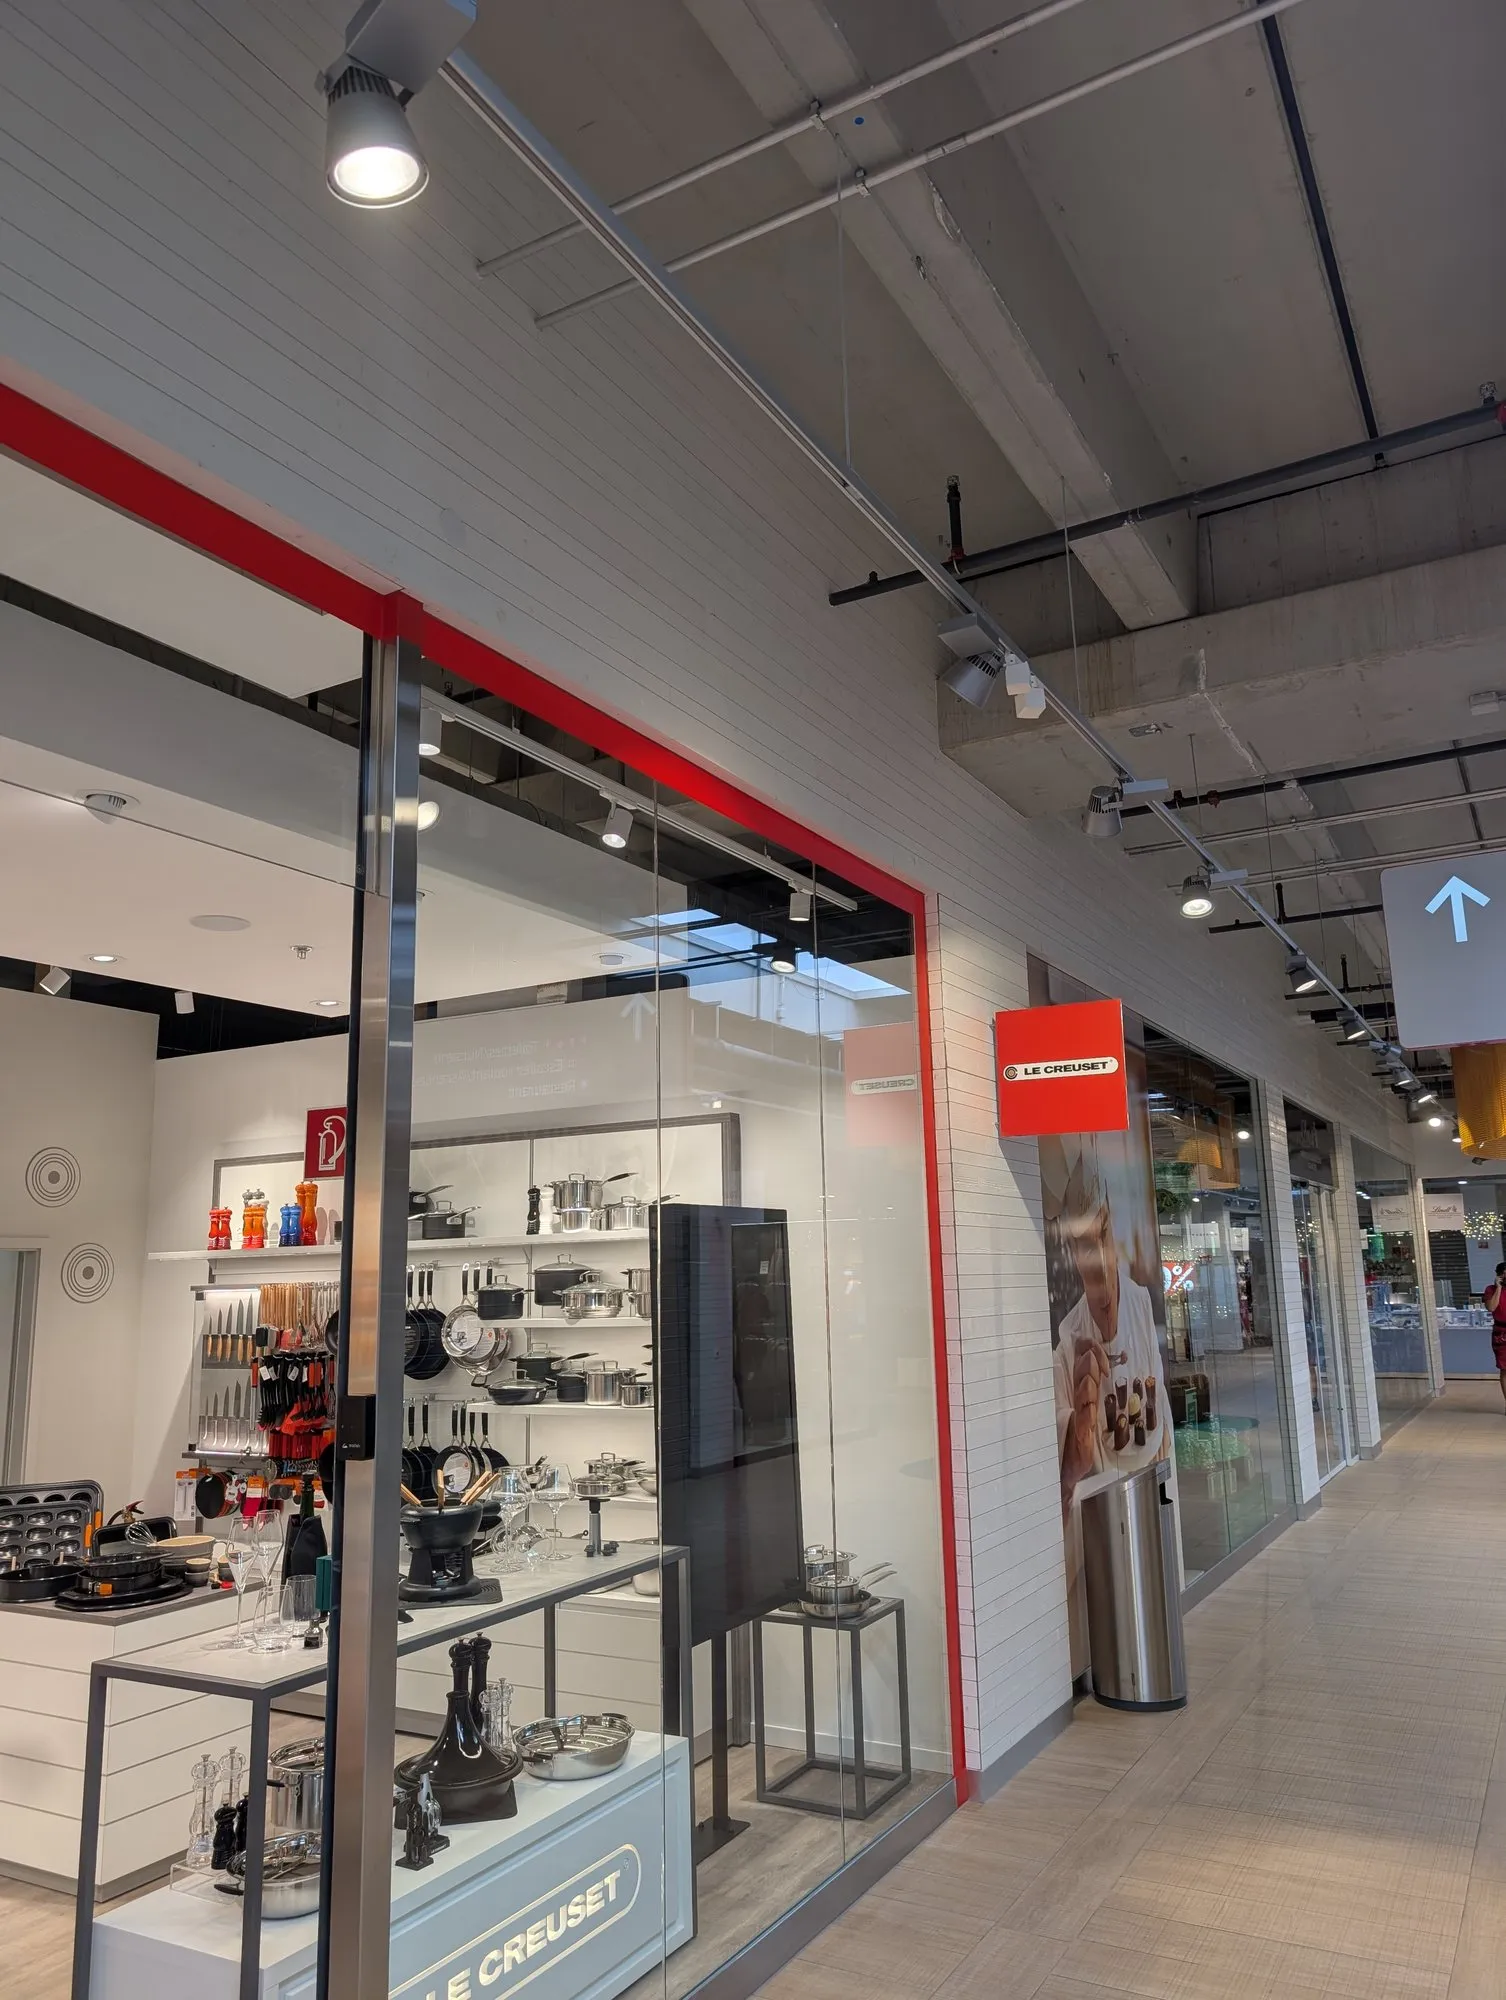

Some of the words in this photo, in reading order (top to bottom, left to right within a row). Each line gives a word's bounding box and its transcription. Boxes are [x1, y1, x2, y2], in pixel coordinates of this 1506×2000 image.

[1024, 1067, 1041, 1076] LE
[1043, 1061, 1109, 1075] CREUSET
[478, 1869, 621, 1987] CREUSET
